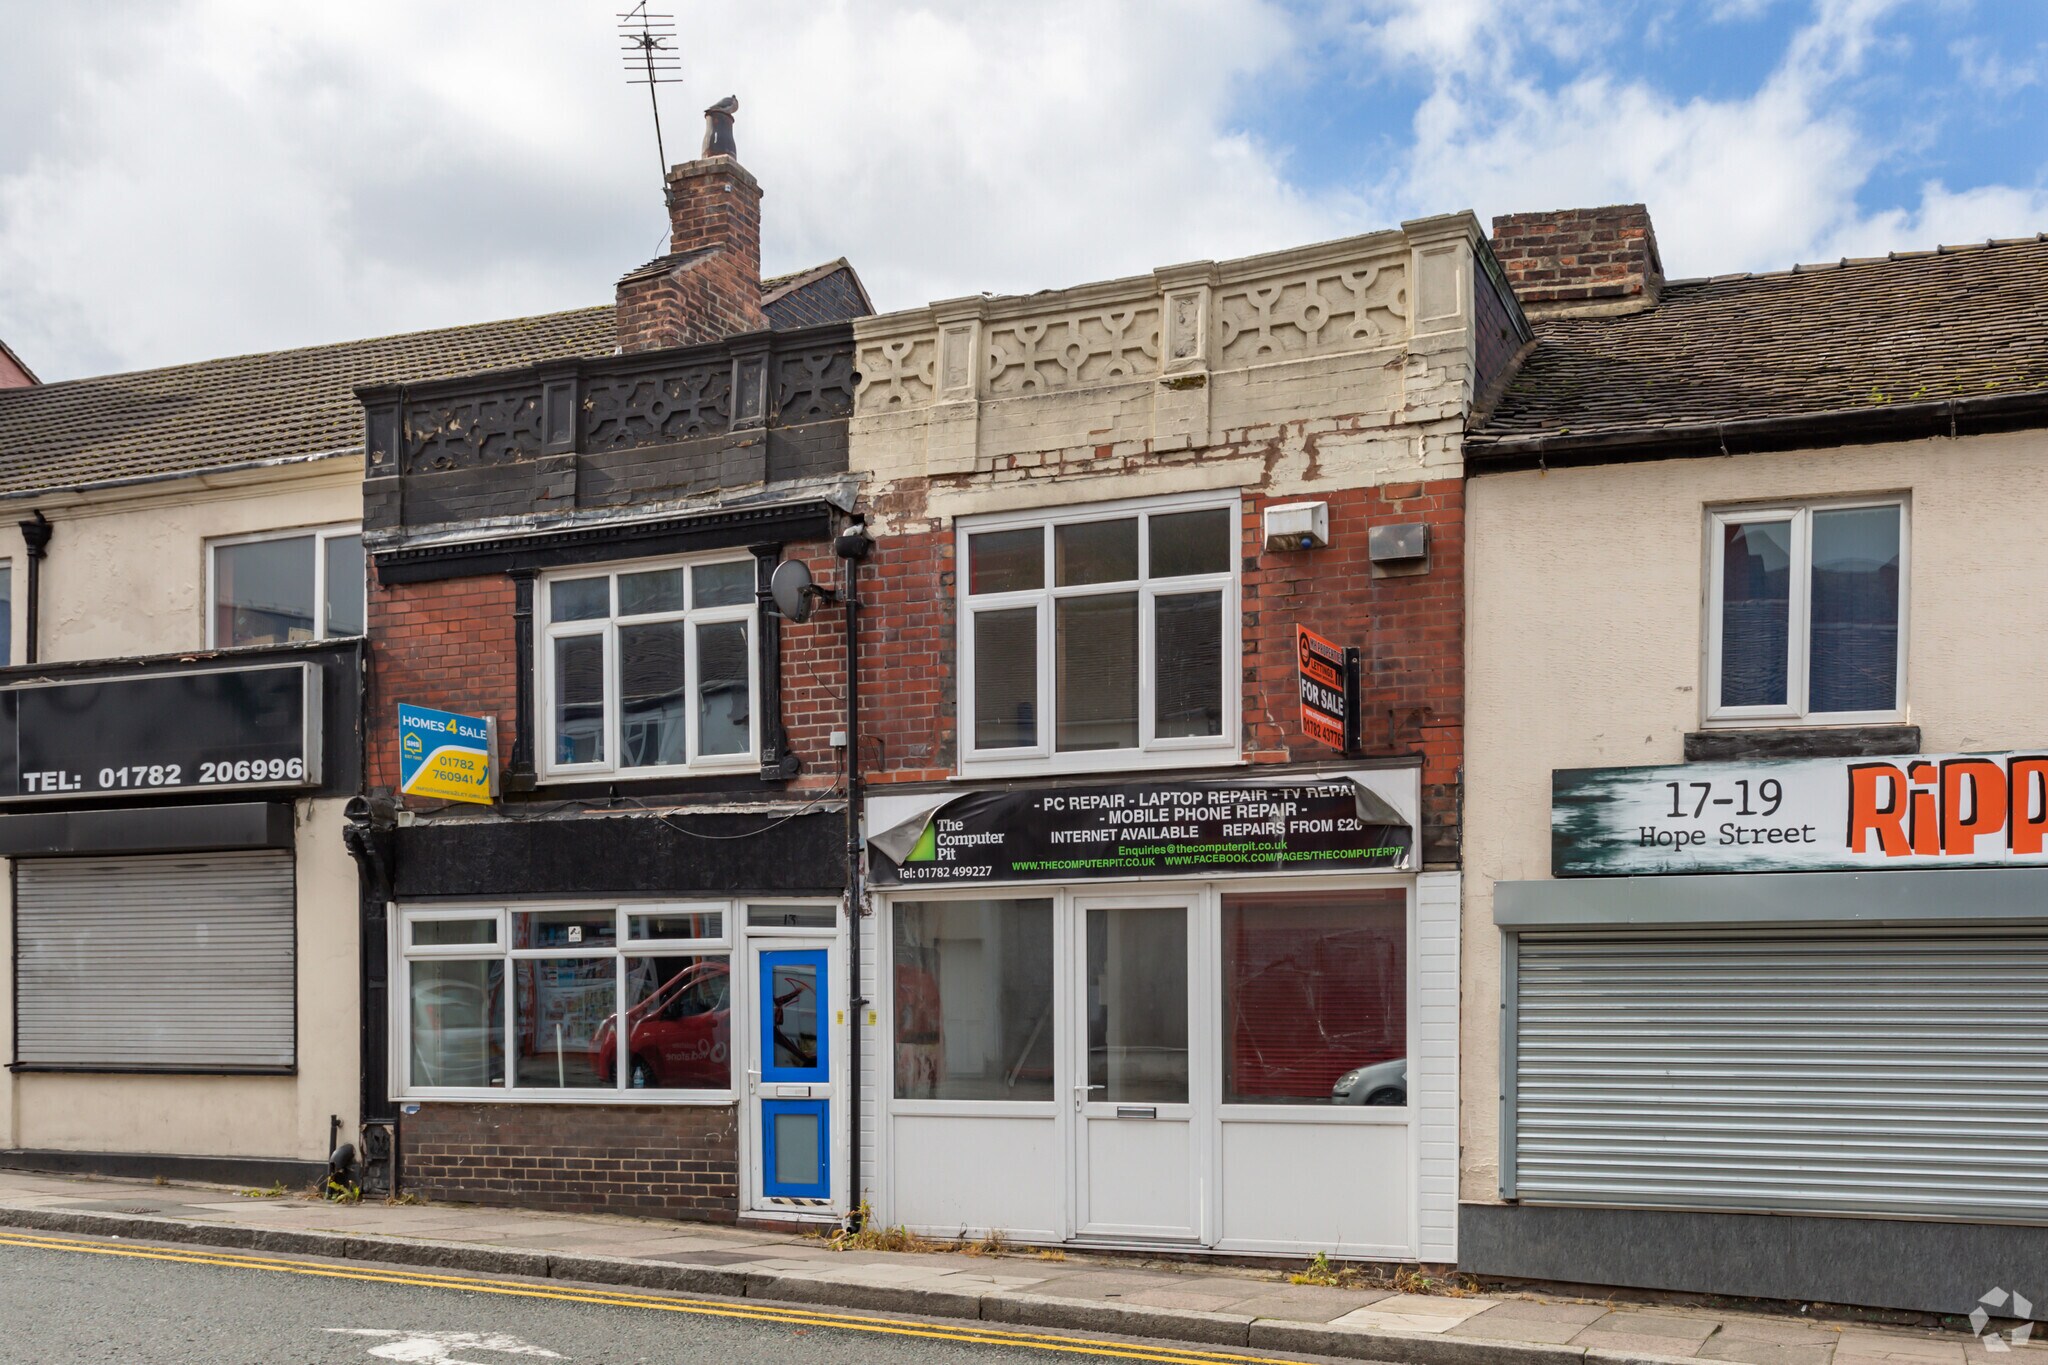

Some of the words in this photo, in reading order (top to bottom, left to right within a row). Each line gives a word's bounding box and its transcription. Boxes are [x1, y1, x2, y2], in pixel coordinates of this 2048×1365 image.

[1312, 662, 1333, 678] LETTINGS
[1302, 678, 1319, 706] FOR
[1321, 690, 1344, 716] SALE
[1303, 718, 1321, 739] 01782
[440, 756, 474, 770] 01782
[24, 771, 81, 792] TEL:
[98, 764, 181, 788] 01782
[199, 757, 303, 783] 206996
[432, 769, 474, 784] 760941
[1044, 798, 1065, 812] PC
[1069, 794, 1125, 810] REPAIR
[1139, 792, 1203, 806] LAPTOP
[1208, 790, 1267, 805] REPAIR
[1280, 788, 1300, 800] TV
[1305, 785, 1356, 798] REPAI
[1666, 778, 1782, 818] 17-19
[1109, 808, 1169, 824] MOBILE
[1174, 806, 1231, 822] PHONE
[1236, 802, 1297, 819] REPAIR
[937, 818, 963, 832] The
[1051, 829, 1117, 844] INTERNET
[1120, 826, 1199, 841] AVAILABLE
[1223, 822, 1285, 836] REPAIRS
[1290, 819, 1333, 834] FROM
[937, 832, 1005, 847] Computer
[1639, 826, 1706, 852] Hope
[1719, 822, 1816, 846] Street
[937, 848, 956, 861] Pit
[1012, 858, 1155, 871] WWW.THECOMPUTERPIT.CO.UK
[1165, 847, 1404, 865] WWW.FACEBOOK.COM/PAGES/THECOMPUTERPIT
[1119, 840, 1287, 857] Enquiries@thecomputerpit.co.uk
[898, 868, 916, 879] Tel:
[917, 867, 950, 878] 01782
[952, 865, 992, 877] 499227
